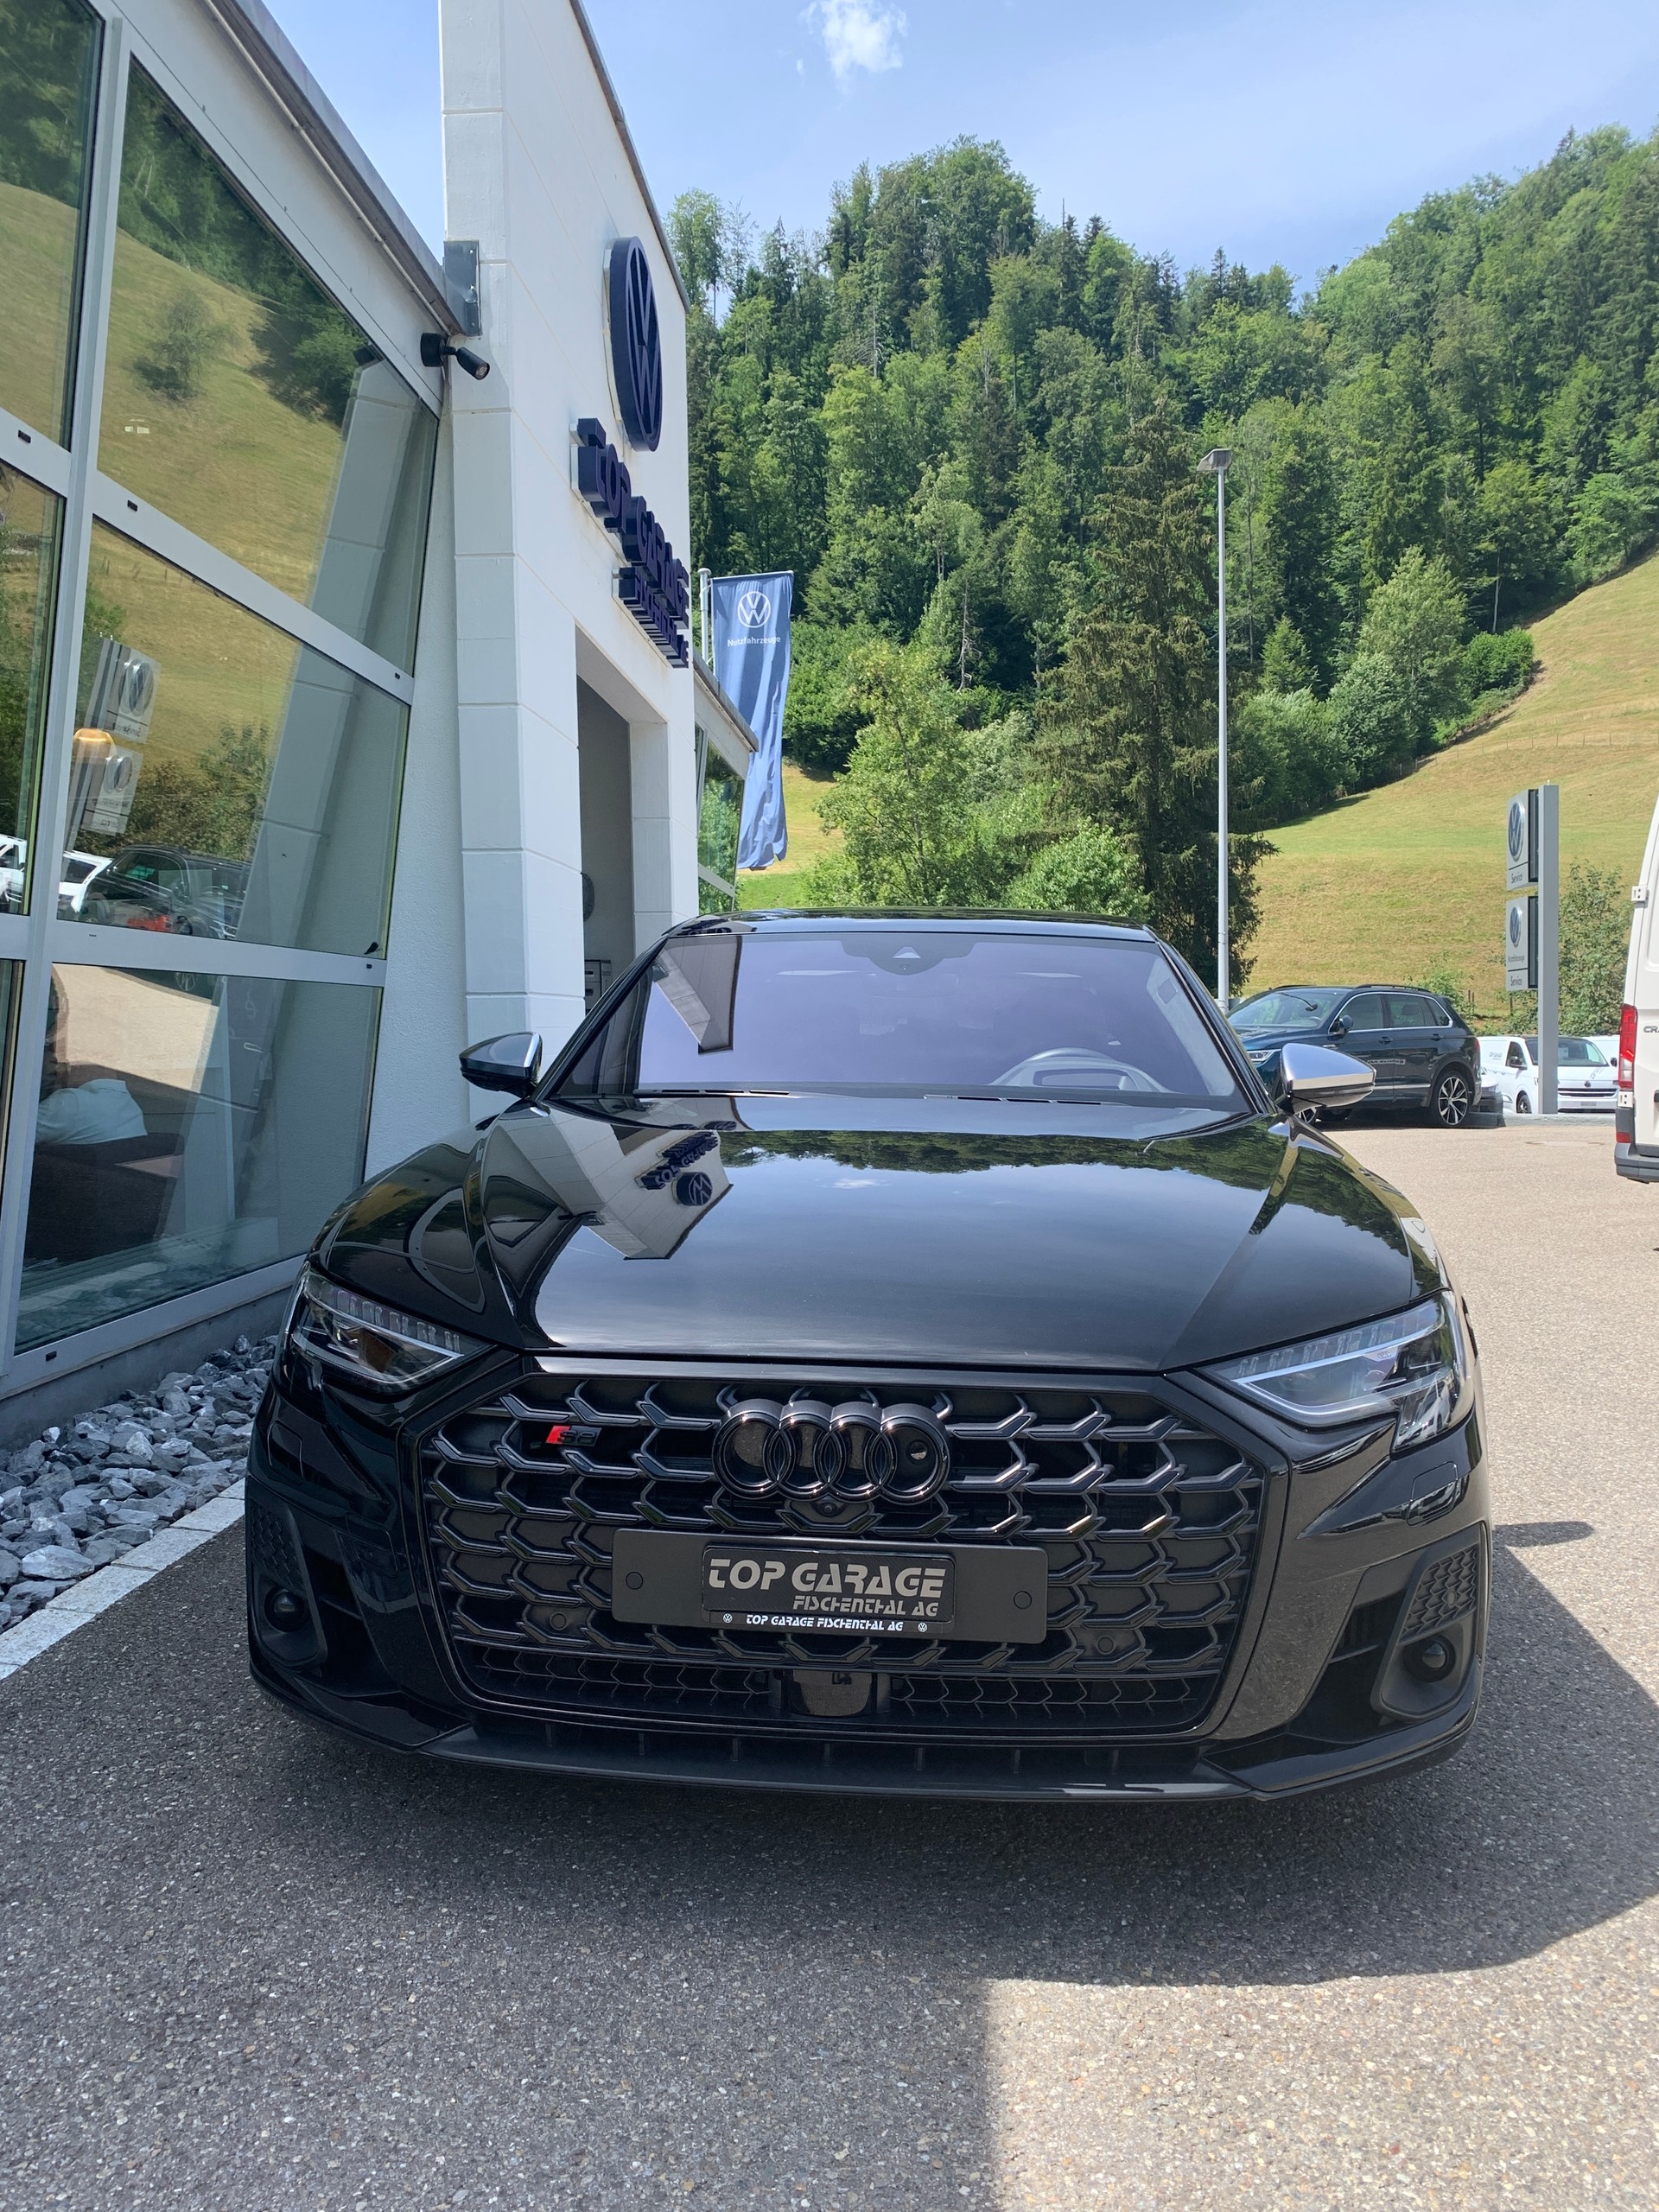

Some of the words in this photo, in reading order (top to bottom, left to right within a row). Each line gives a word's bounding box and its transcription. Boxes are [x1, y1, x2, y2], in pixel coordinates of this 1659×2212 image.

[577, 417, 632, 532] TOP
[622, 495, 689, 630] GARAGE
[727, 636, 781, 647] Nutzfahrzeuge
[1510, 871, 1523, 884] Service
[1510, 976, 1522, 987] Service
[709, 1558, 786, 1590] TOP
[791, 1562, 946, 1599] GARAGE
[791, 1595, 906, 1617] FISCHENTHAL
[911, 1601, 939, 1618] AG
[746, 1614, 768, 1625] TOP
[770, 1616, 814, 1628] GARAGE
[817, 1618, 885, 1630] FISCHENTHAL
[887, 1620, 904, 1631] AG
